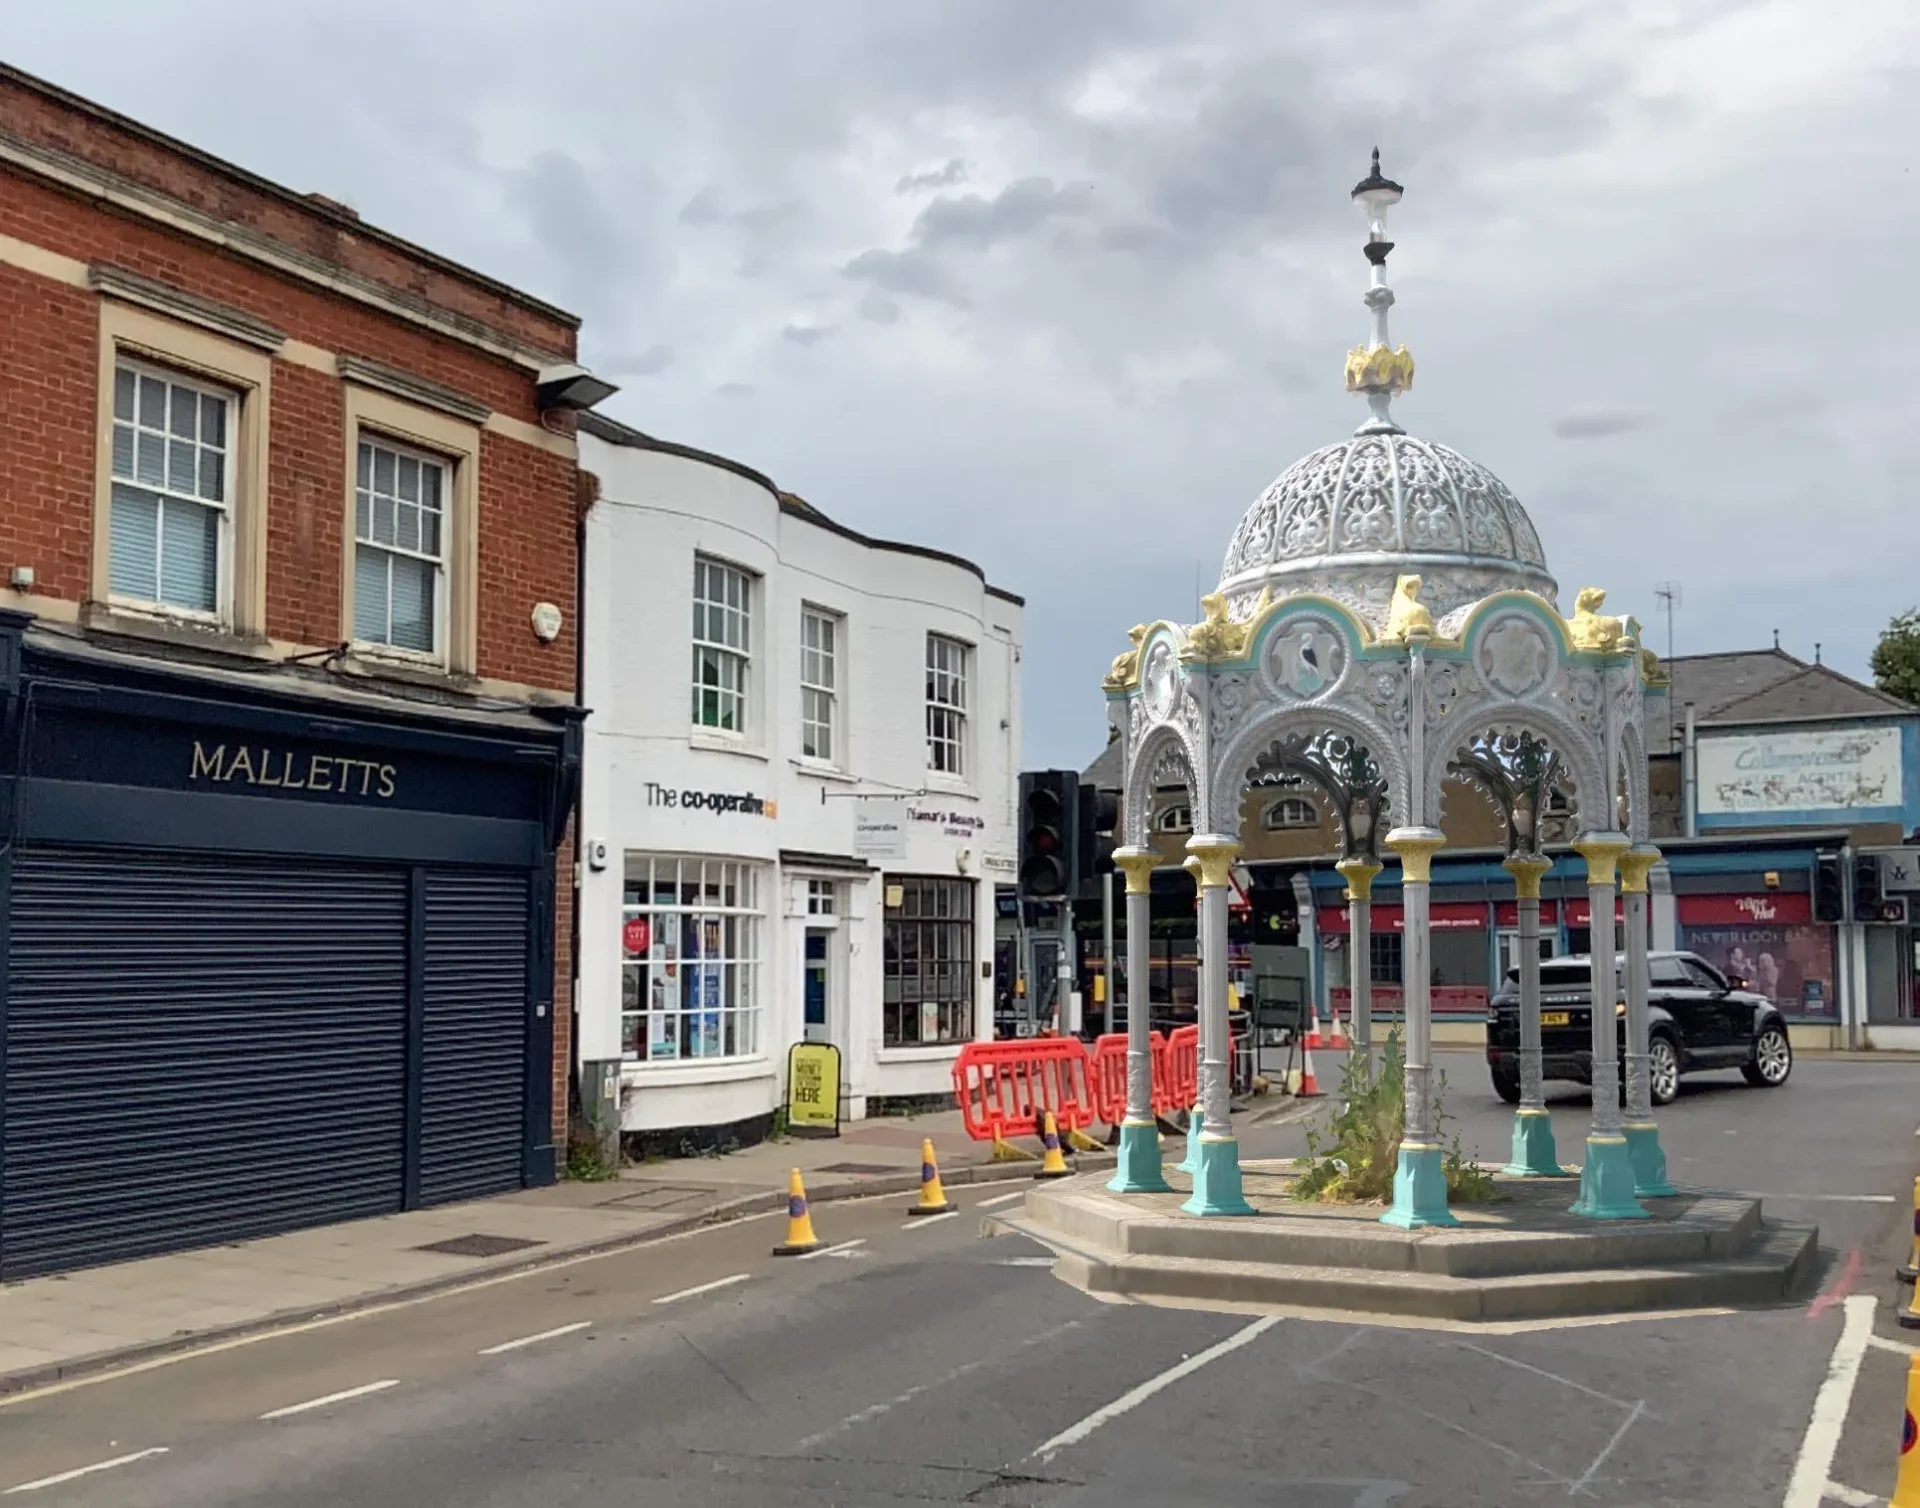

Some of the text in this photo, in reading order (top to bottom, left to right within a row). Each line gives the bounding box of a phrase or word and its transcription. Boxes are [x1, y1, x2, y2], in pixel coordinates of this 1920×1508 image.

[188, 741, 397, 798] MALLETTS
[644, 783, 763, 816] The co-operative
[1691, 931, 1740, 944] NEVER
[796, 1087, 821, 1104] HERE
